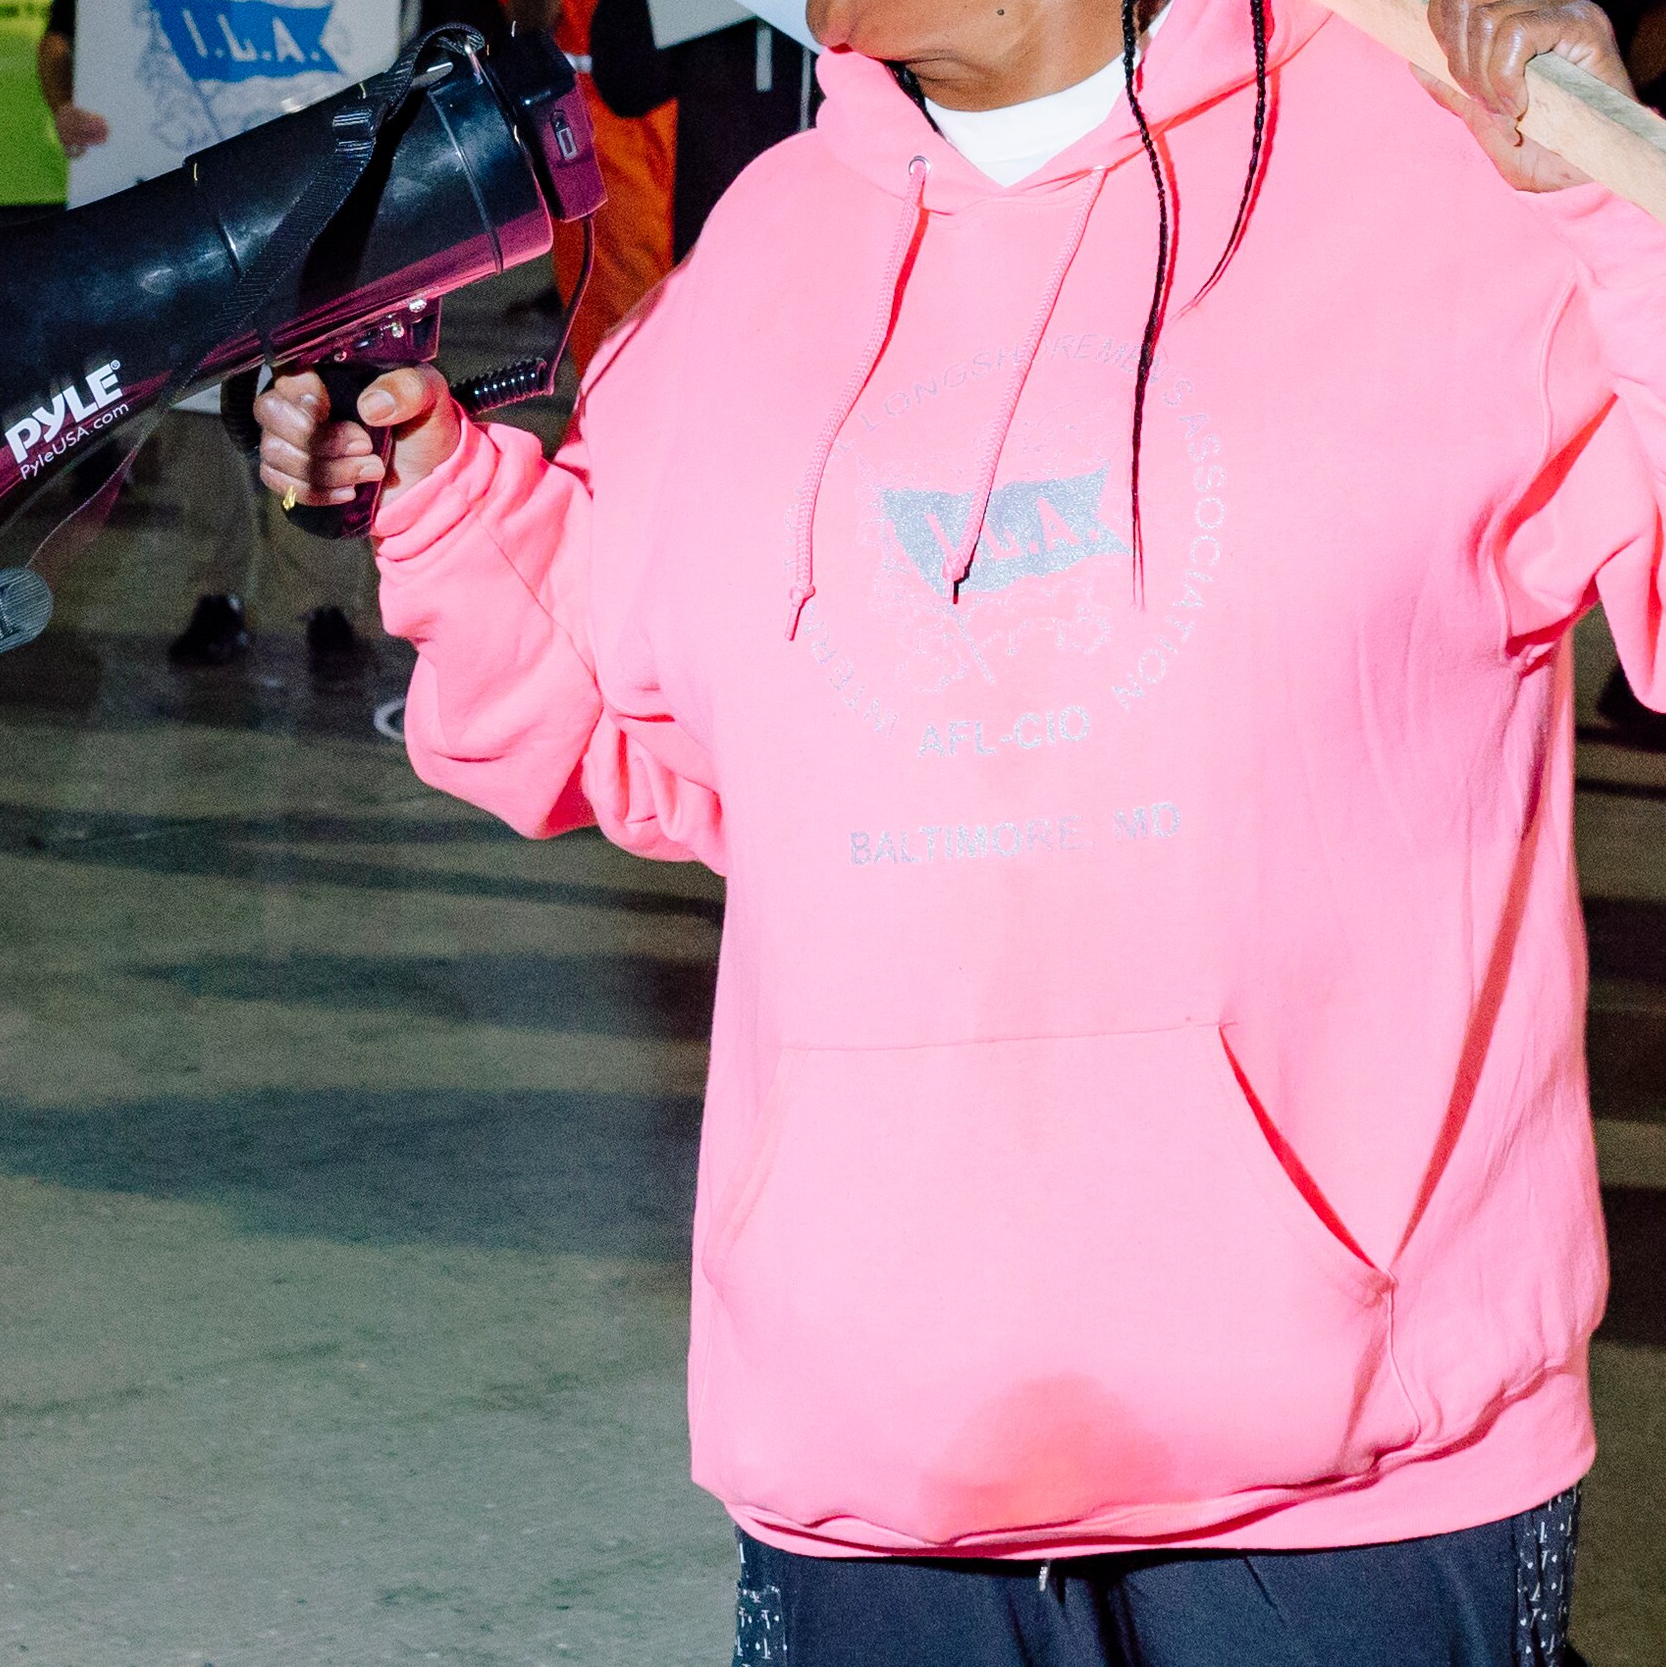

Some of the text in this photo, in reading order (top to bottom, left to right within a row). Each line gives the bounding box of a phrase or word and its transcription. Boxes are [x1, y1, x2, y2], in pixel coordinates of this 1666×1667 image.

[182, 9, 321, 64] I.L.A.
[4, 363, 123, 464] PYLE
[20, 402, 130, 480] PyleUSA.com
[923, 496, 1100, 566] IL.A.
[1111, 412, 1228, 712] ASSOCIATION
[918, 704, 1091, 758] AFL-CIO
[1114, 801, 1181, 842] MD
